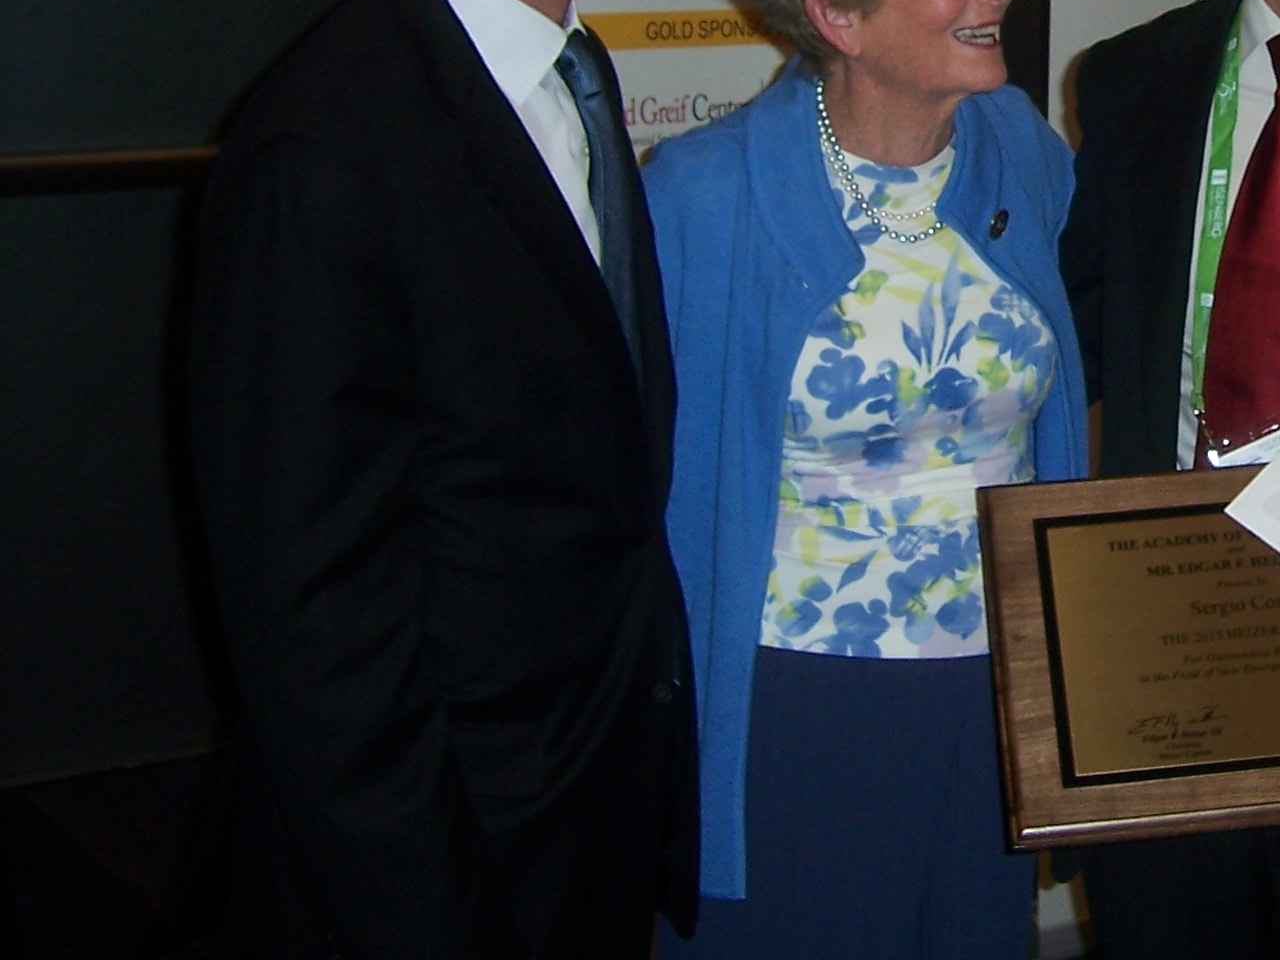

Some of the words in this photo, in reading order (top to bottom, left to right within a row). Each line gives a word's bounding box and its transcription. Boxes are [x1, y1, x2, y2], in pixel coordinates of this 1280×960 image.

[646, 20, 693, 40] GOLD
[641, 94, 690, 125] Greif
[1108, 540, 1139, 551] THE
[1143, 532, 1219, 549] ACADEMY
[1178, 559, 1231, 573] EDGAR
[1191, 600, 1247, 617] Sergio
